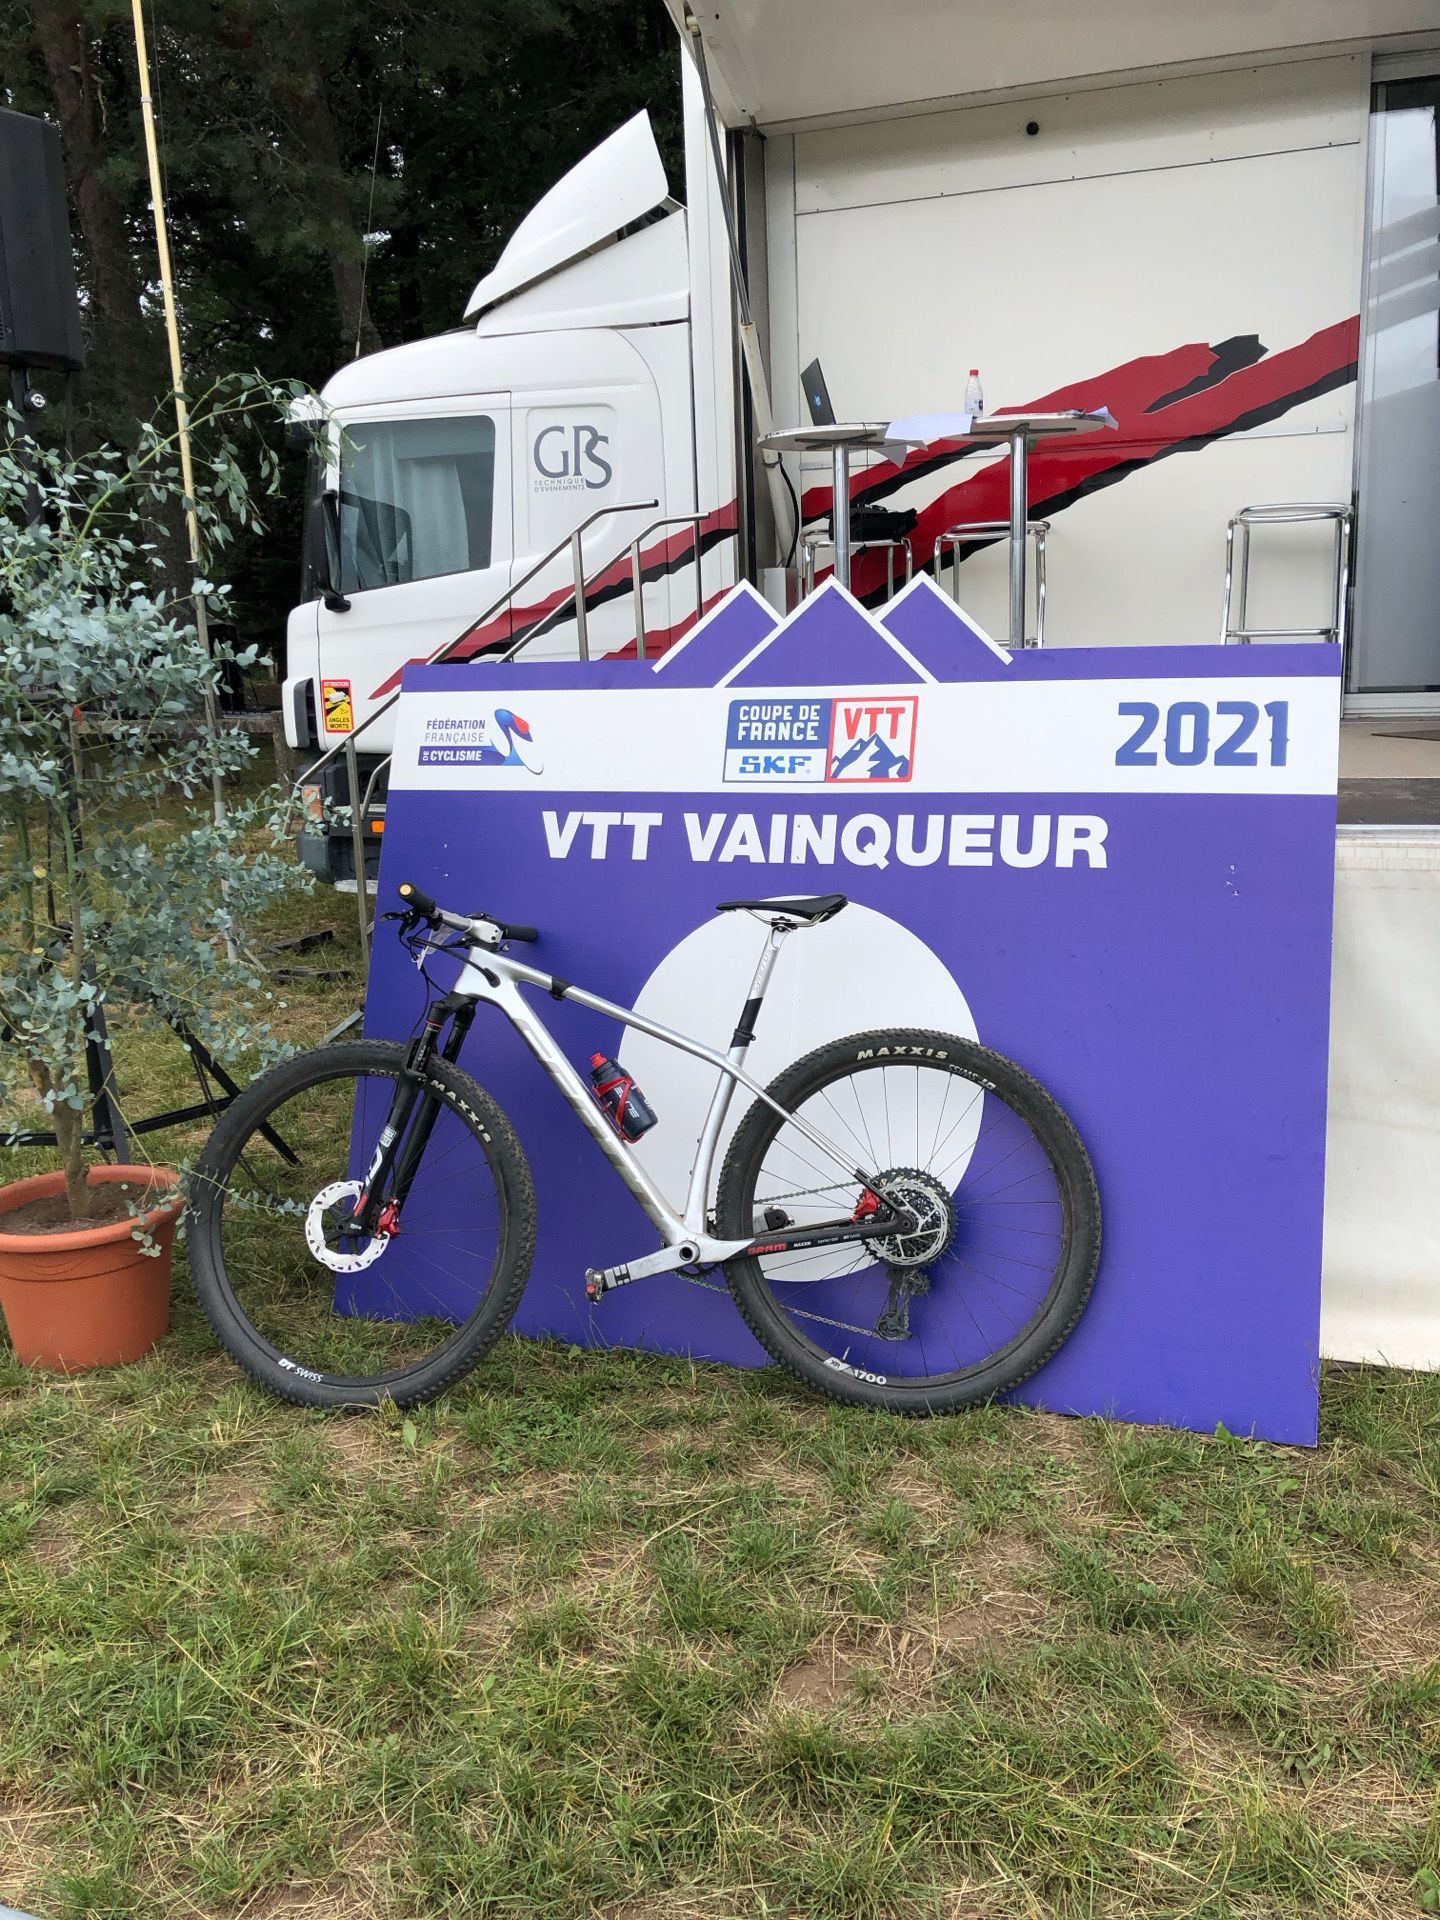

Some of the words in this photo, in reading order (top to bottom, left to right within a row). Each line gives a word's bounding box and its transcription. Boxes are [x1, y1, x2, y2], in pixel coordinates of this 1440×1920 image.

[534, 478, 585, 487] TECHNIQUE
[739, 705, 793, 721] COUPE
[798, 705, 821, 720] DE
[427, 717, 486, 730] FÉDÉRATION
[737, 722, 820, 741] FRANCE
[844, 707, 906, 740] VTT
[424, 732, 485, 745] FRANÇAISE
[1115, 701, 1290, 767] 2021
[422, 750, 430, 761] DE
[429, 750, 483, 762] CYCLISME
[739, 756, 812, 774] SKF
[542, 811, 663, 860] VTT
[683, 812, 1109, 870] VAINQUEUR
[856, 1046, 949, 1060] MAXXIS
[430, 1079, 492, 1143] MAXXIS
[278, 1358, 296, 1370] DT
[294, 1367, 324, 1383] SWISS
